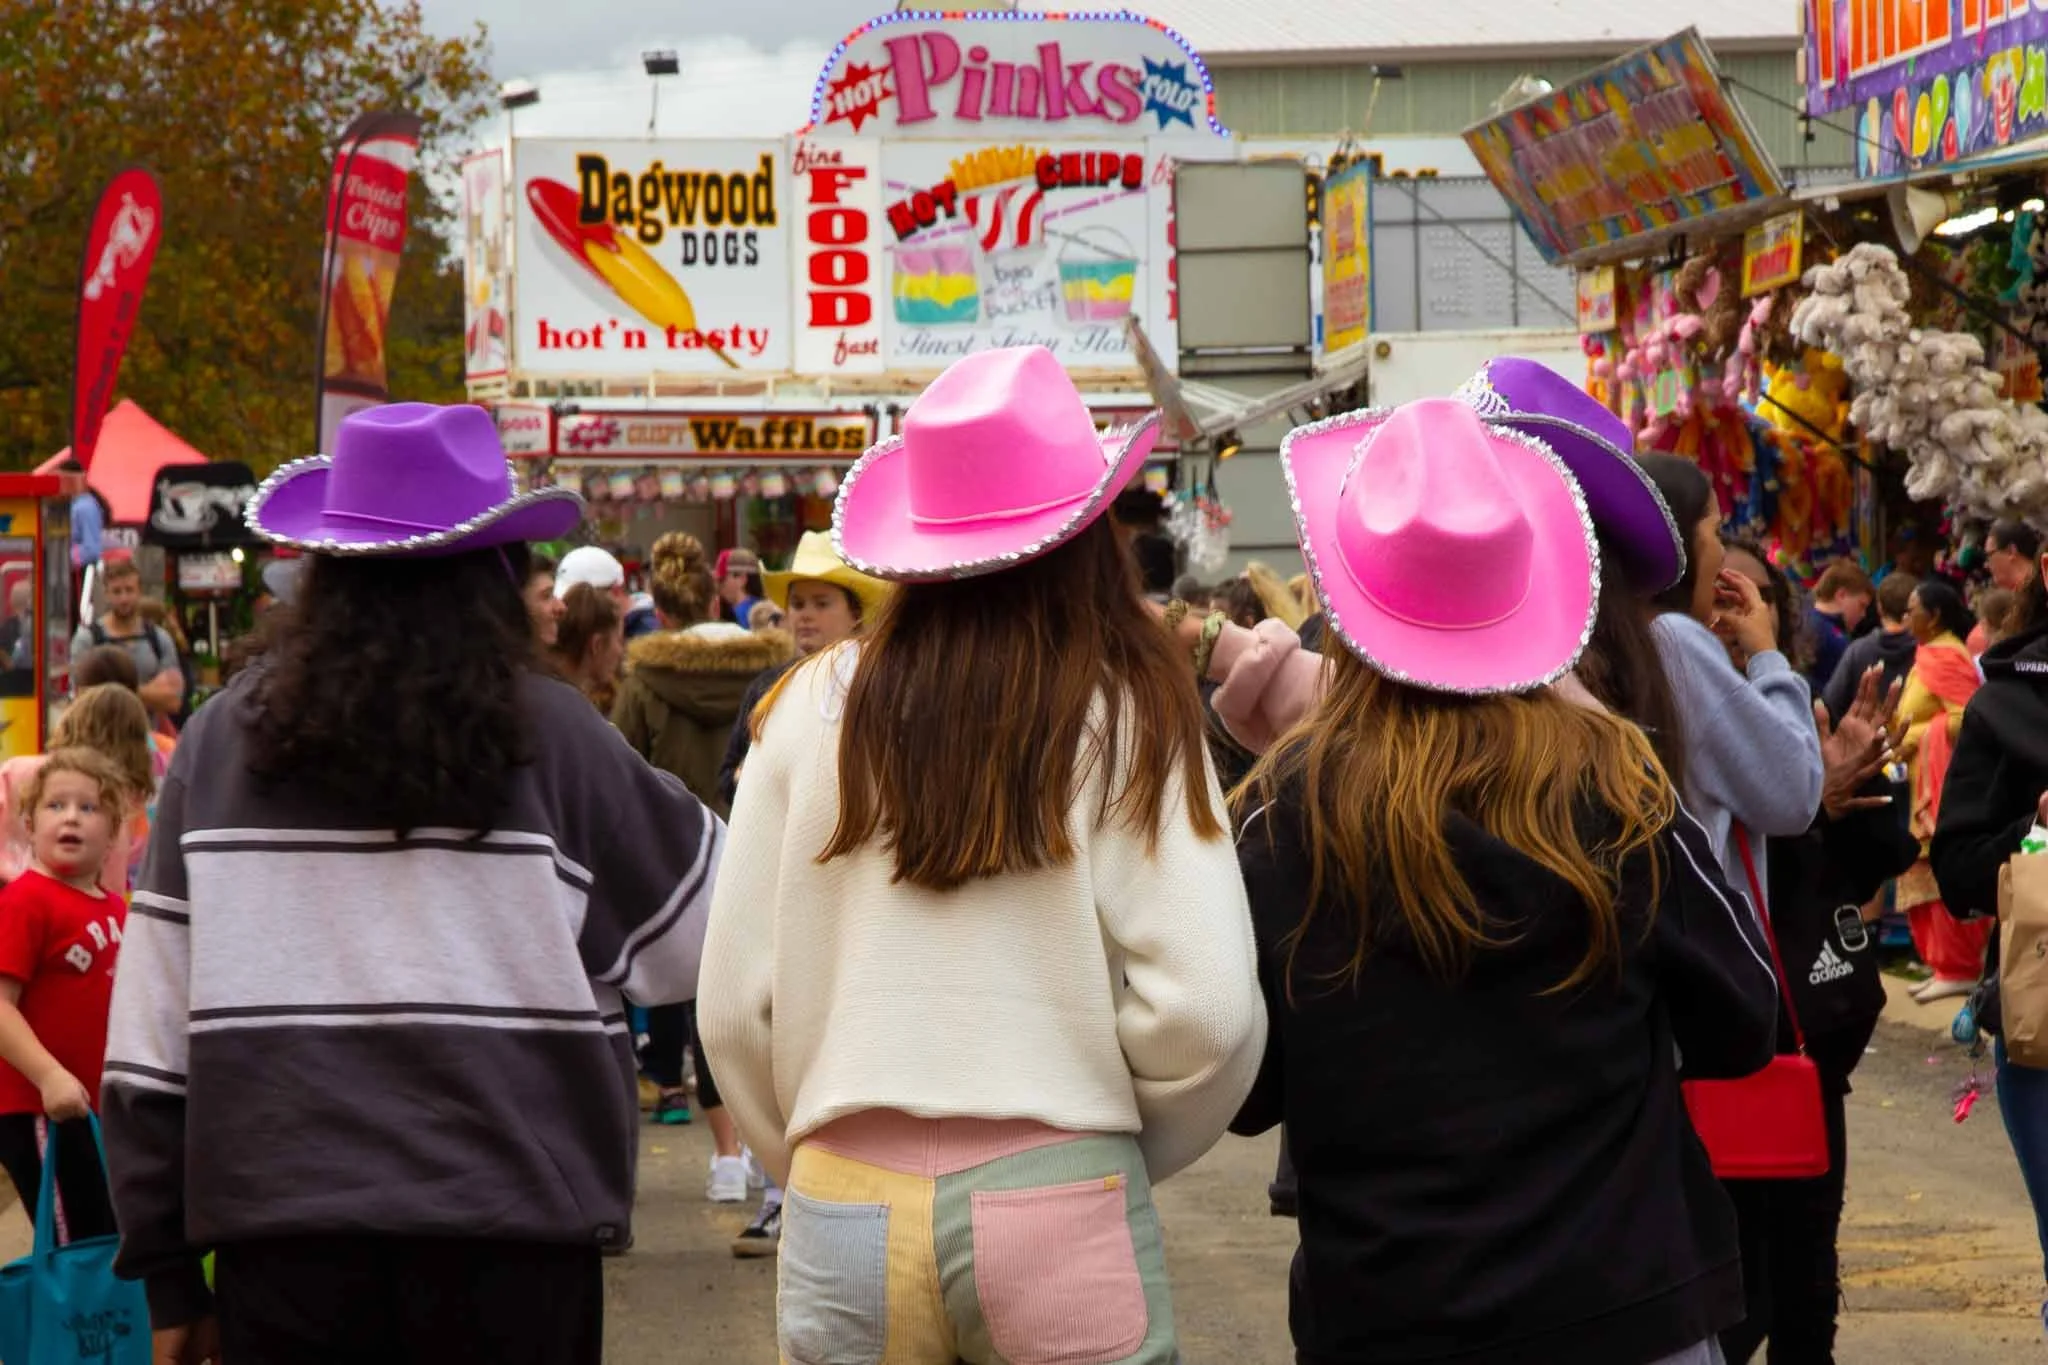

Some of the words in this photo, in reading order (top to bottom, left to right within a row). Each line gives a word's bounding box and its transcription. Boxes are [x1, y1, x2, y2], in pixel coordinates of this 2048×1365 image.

[834, 73, 886, 115] HOT
[883, 31, 1143, 125] Pinks
[793, 141, 842, 175] fine
[1036, 152, 1143, 190] CHIPS
[577, 153, 777, 245] Dagwood
[887, 180, 958, 242] HOT
[682, 231, 758, 266] DOGS
[808, 167, 871, 328] FOOD
[537, 319, 647, 350] hot'n
[666, 323, 770, 356] tasty
[833, 333, 879, 366] fast
[1069, 324, 1130, 353] Flos
[690, 417, 864, 451] Waffles
[64, 915, 123, 973] BRA
[1808, 961, 1854, 985] adidas
